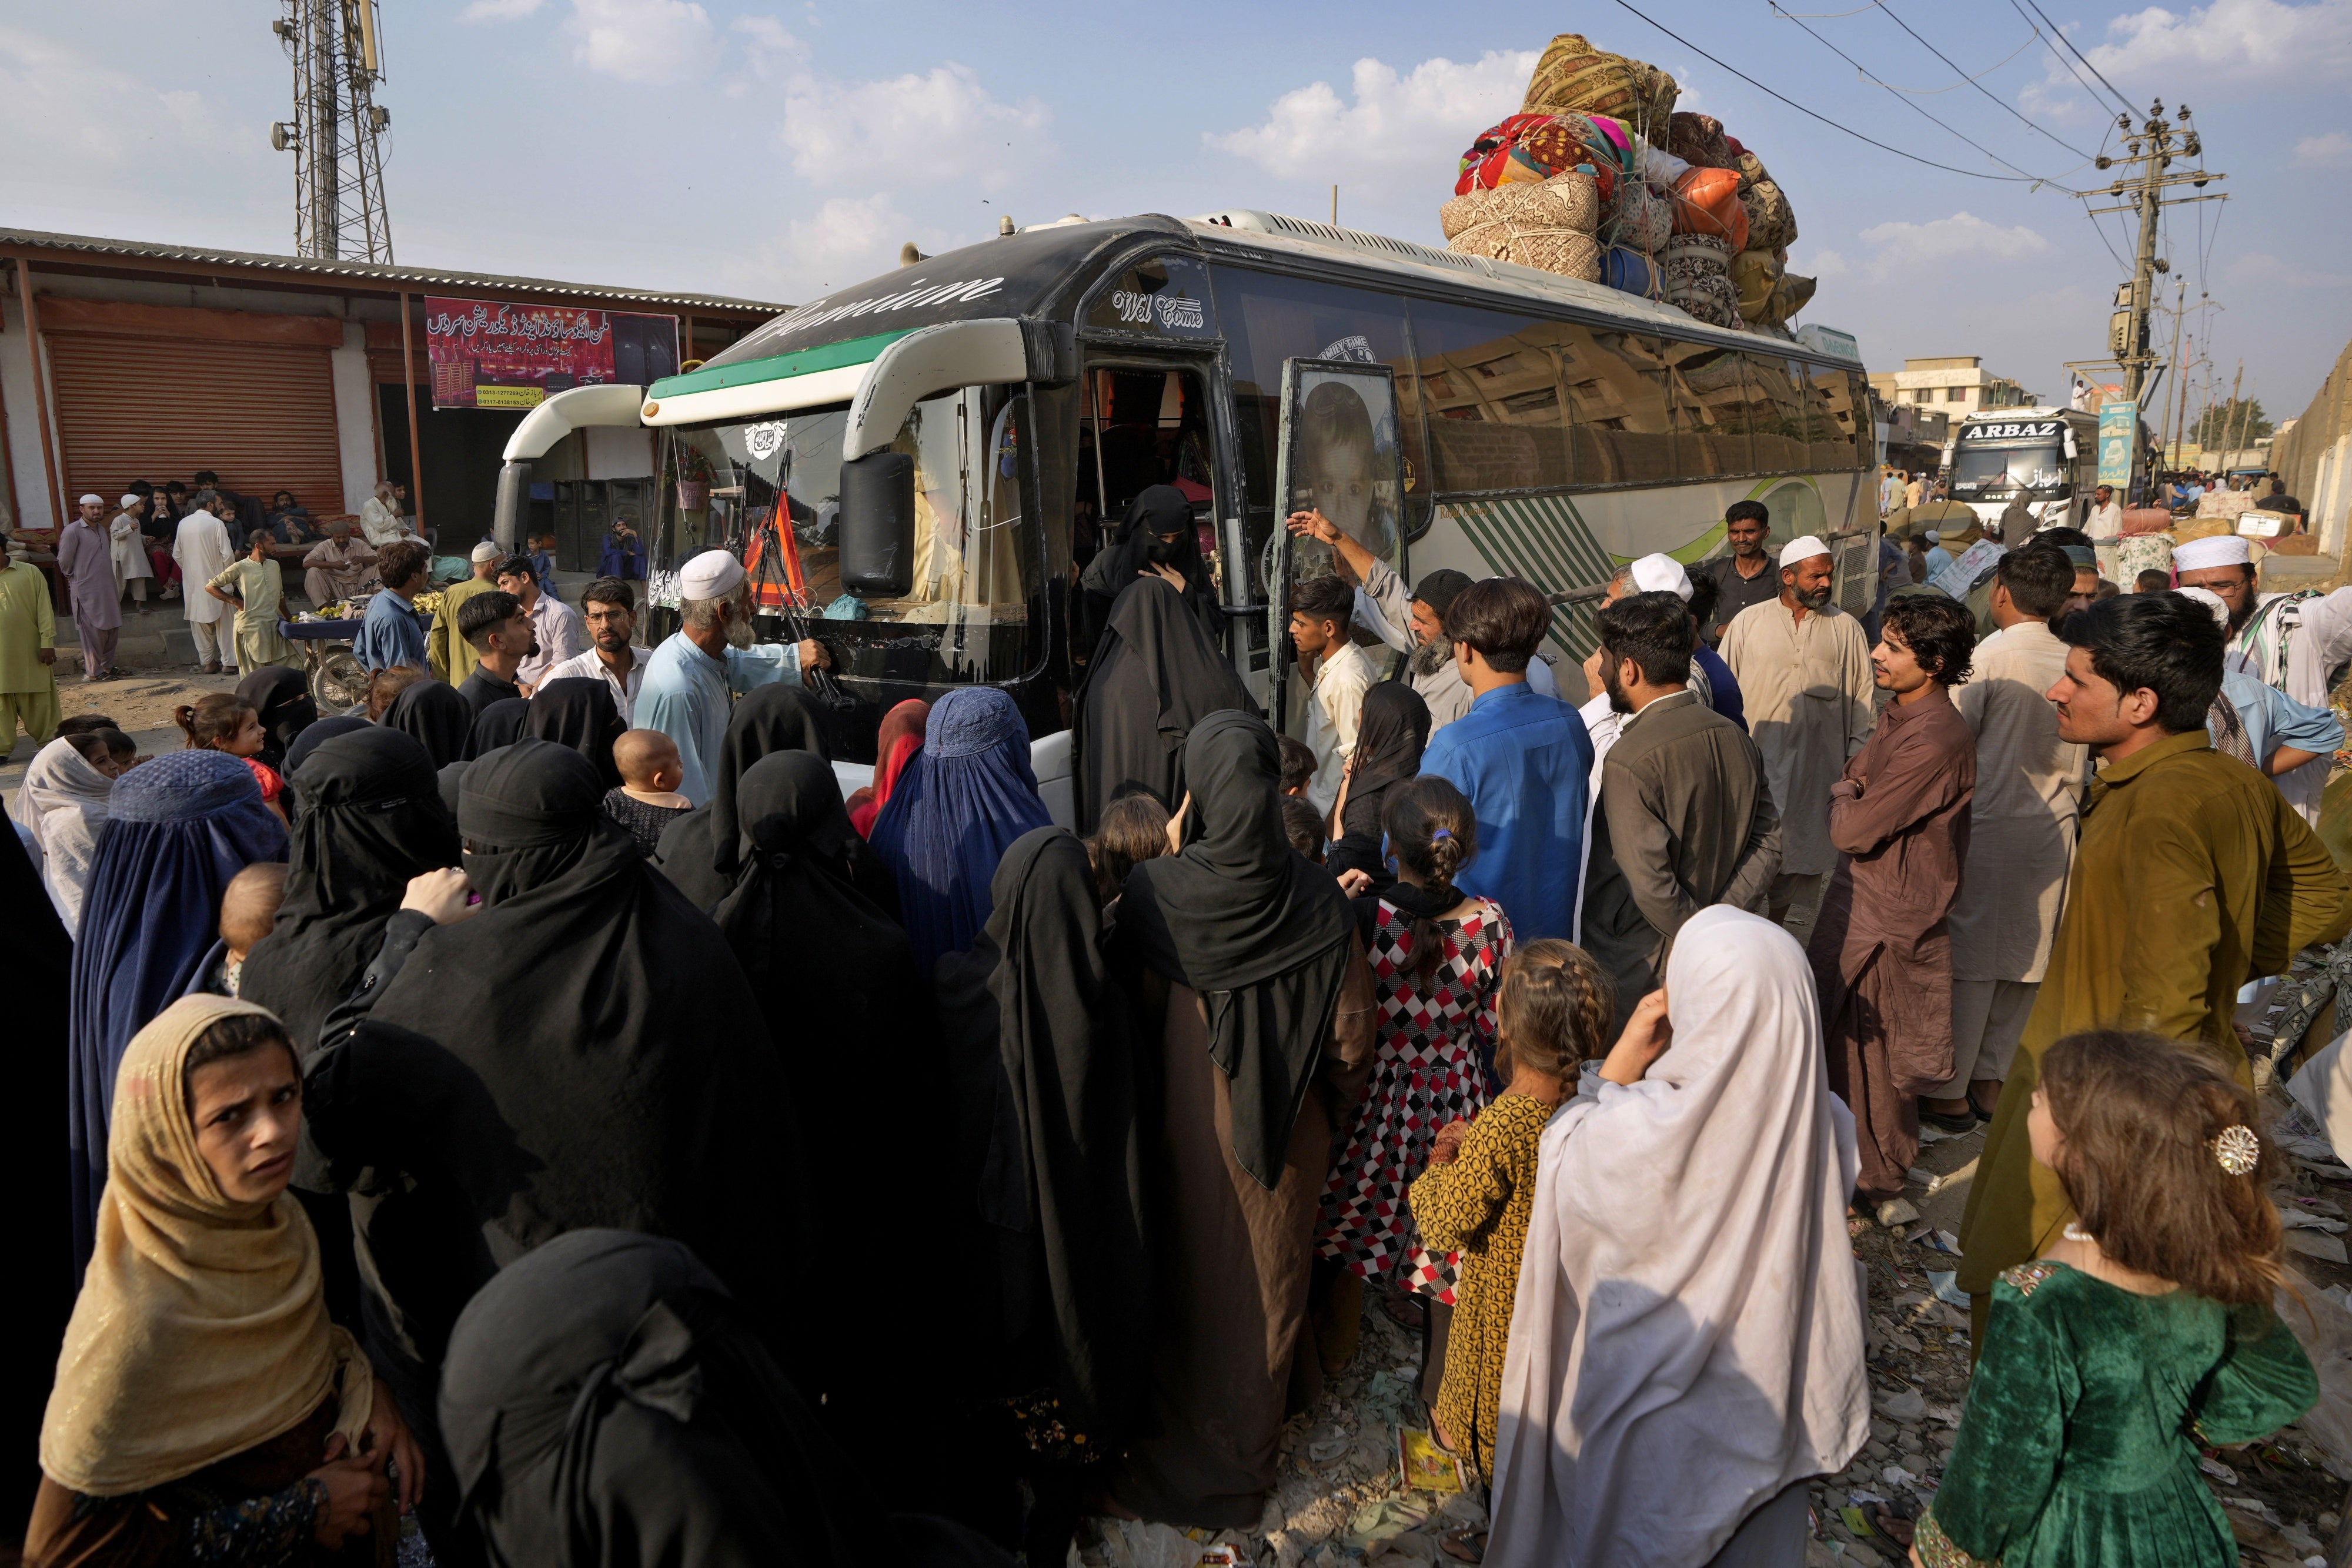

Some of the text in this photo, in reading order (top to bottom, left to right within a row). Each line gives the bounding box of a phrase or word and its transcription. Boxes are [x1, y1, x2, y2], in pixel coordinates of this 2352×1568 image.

[707, 278, 1004, 362] Premium
[1112, 290, 1204, 329] Wel Come
[427, 313, 465, 336] سروس
[589, 312, 609, 345] ملن
[1317, 339, 1345, 360] AMILY
[1344, 336, 1369, 350] TIME
[1966, 423, 2057, 439] ARBAZ
[2025, 467, 2063, 489] ارباز
[1440, 504, 1460, 520] Royal
[1463, 504, 1488, 518] Luxury
